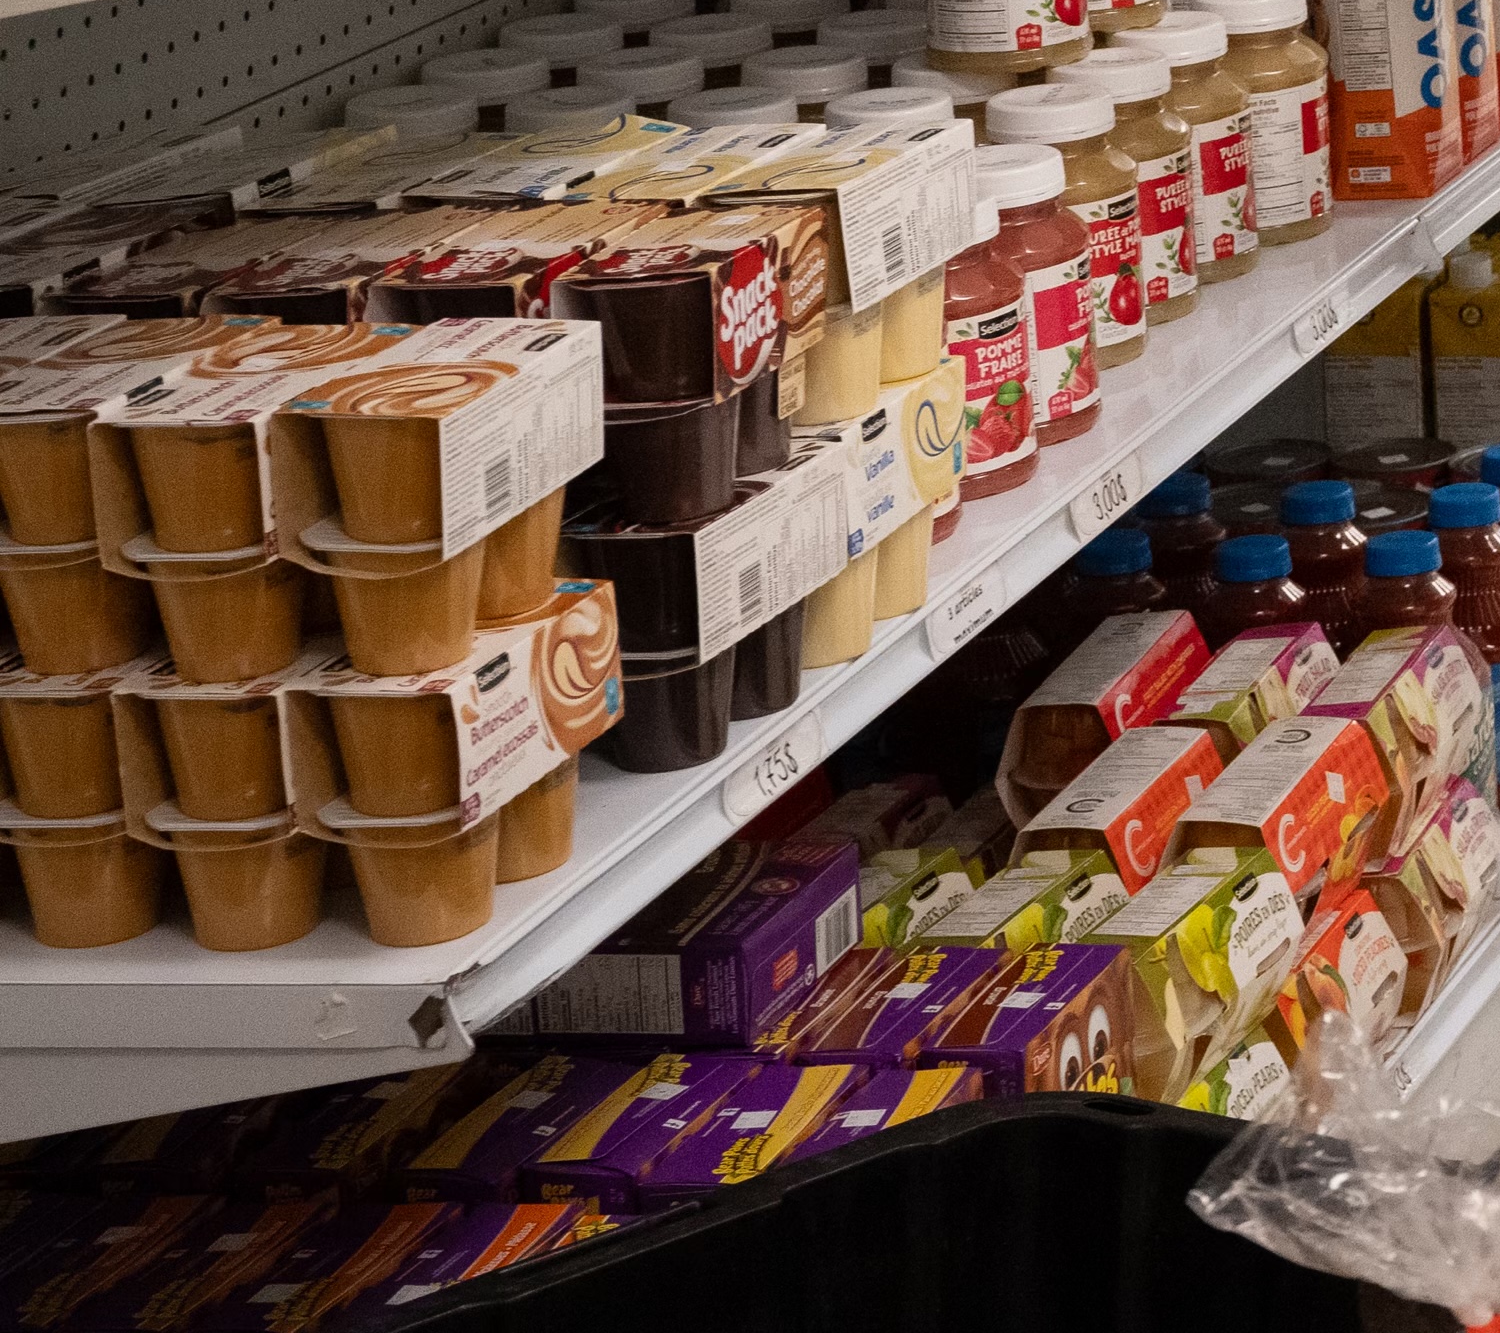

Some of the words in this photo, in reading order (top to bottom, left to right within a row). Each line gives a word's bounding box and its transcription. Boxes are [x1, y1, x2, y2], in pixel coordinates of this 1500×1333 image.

[721, 261, 776, 337] Snack
[733, 306, 779, 369] pack
[980, 315, 1018, 338] Selection
[975, 333, 1023, 363] POMME
[979, 350, 1024, 379] FRAISE
[865, 448, 896, 482] Vanilla
[867, 492, 896, 523] vanille
[954, 583, 984, 615] articles
